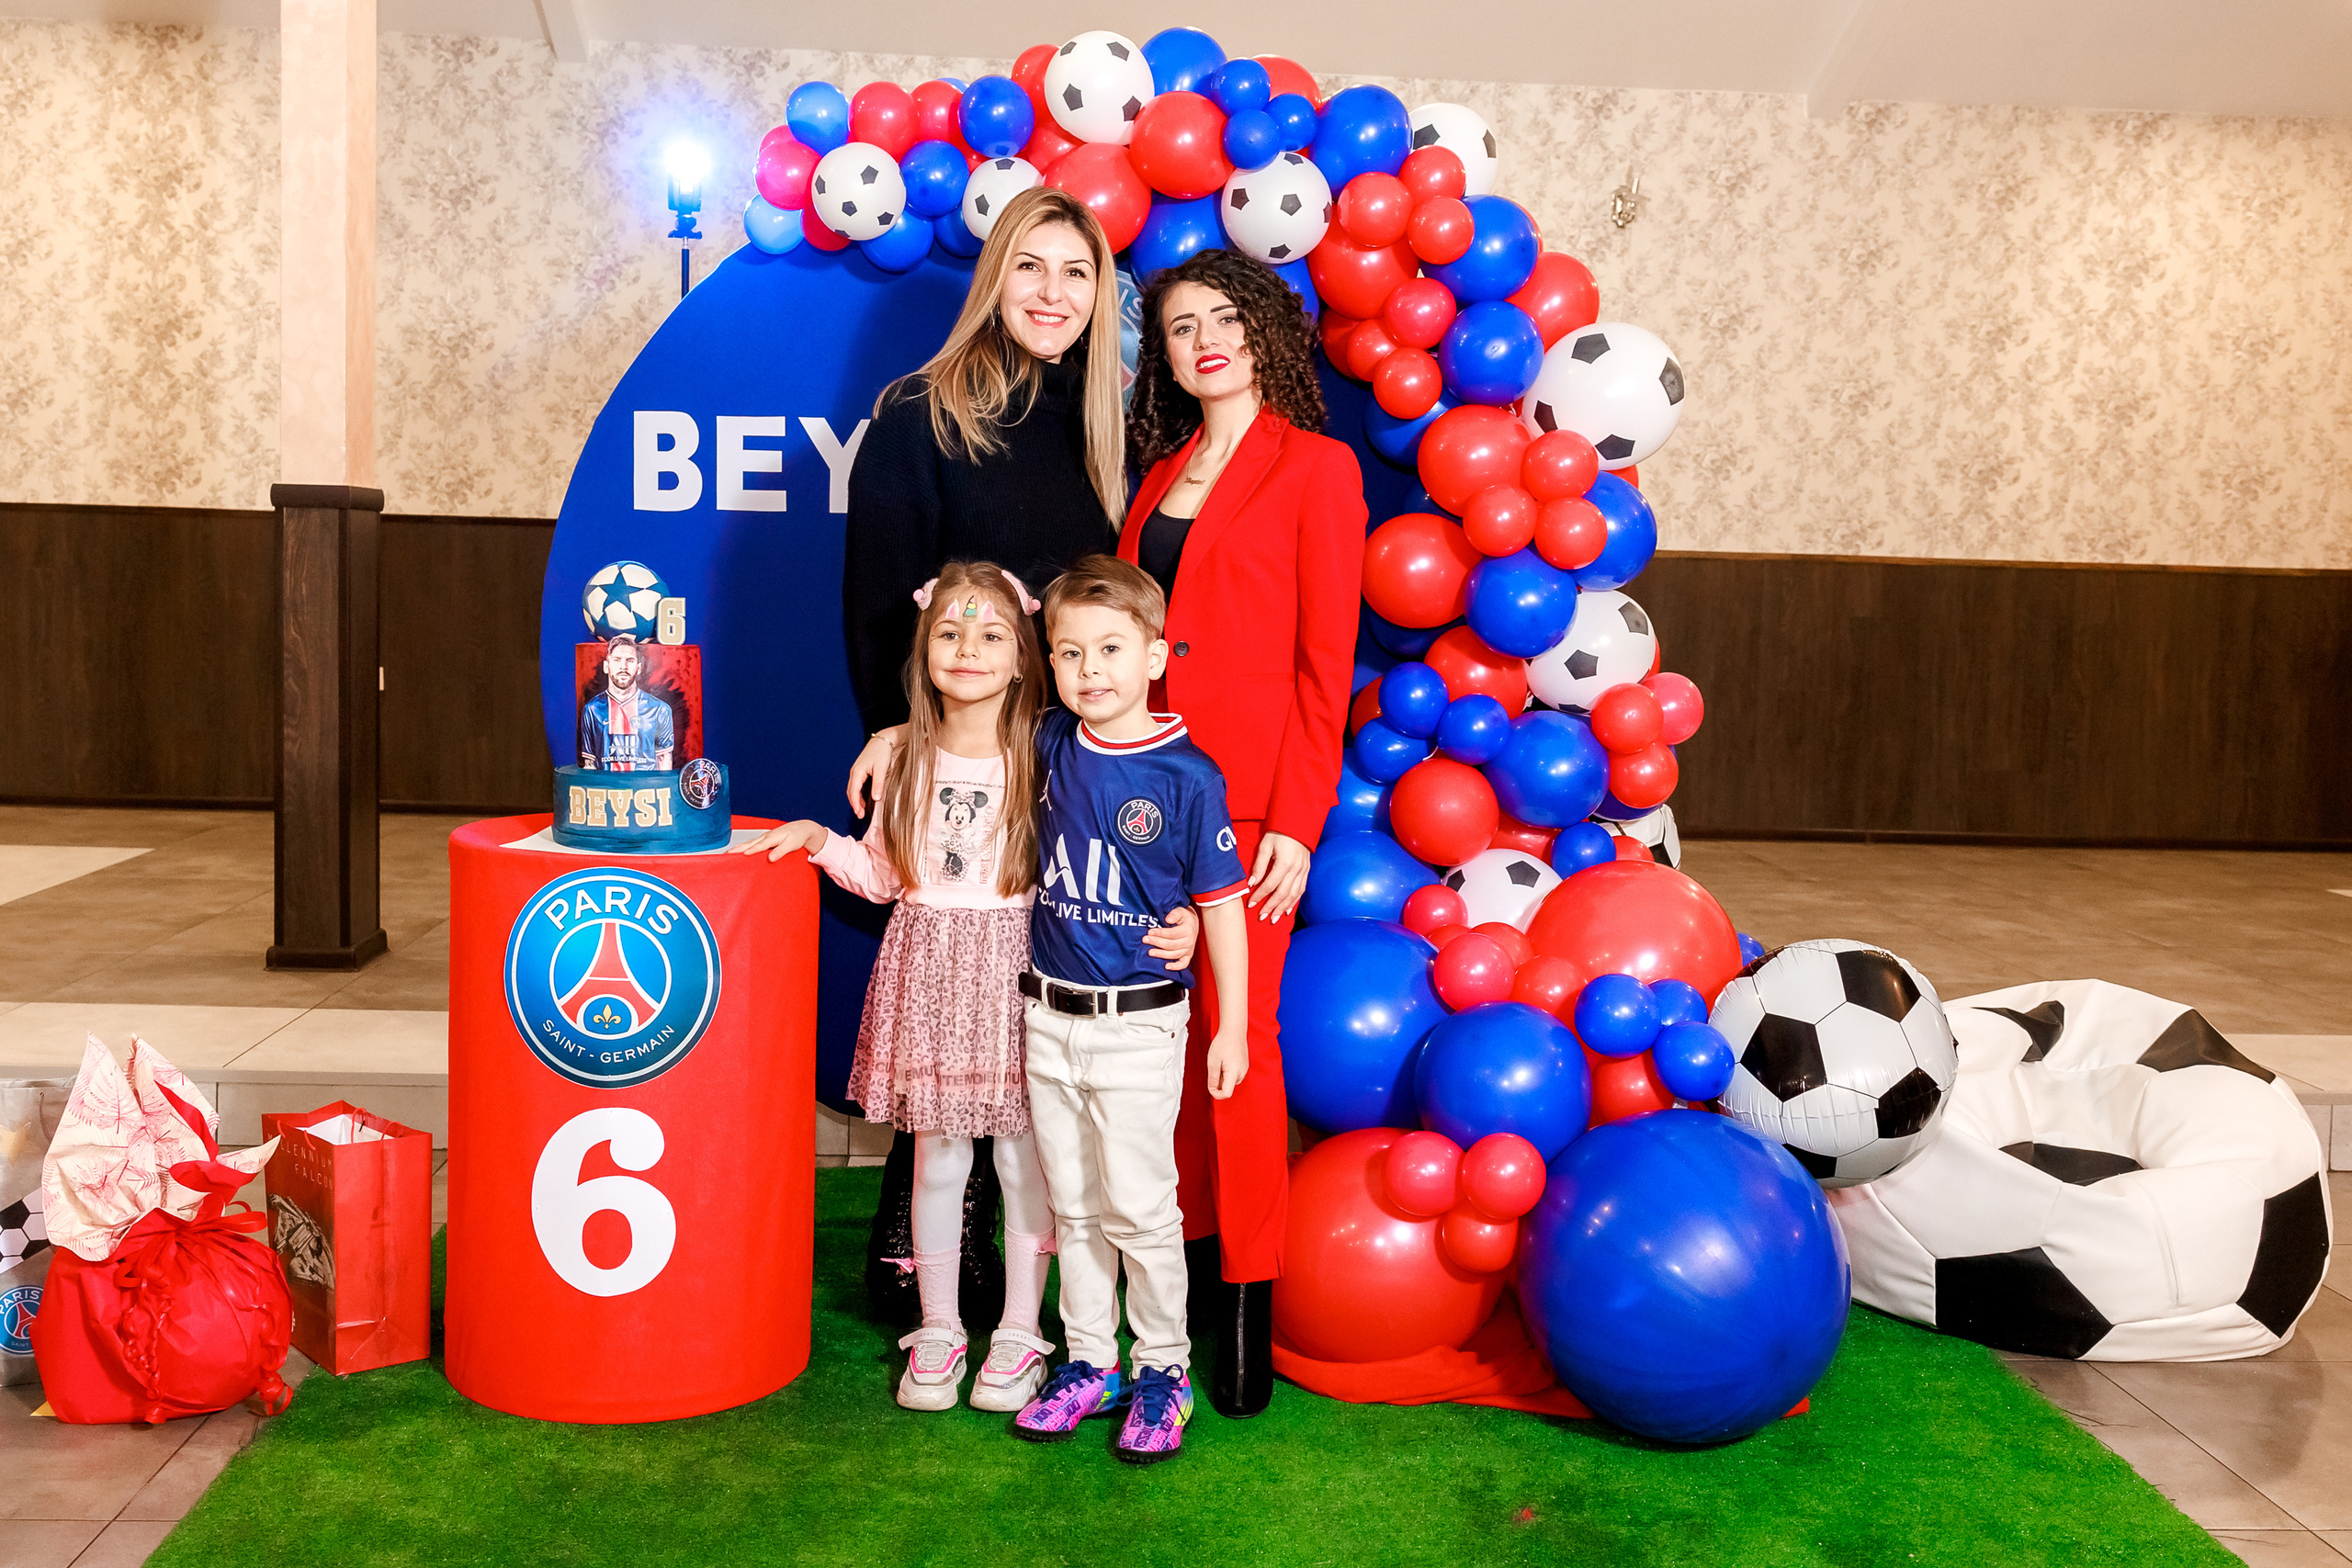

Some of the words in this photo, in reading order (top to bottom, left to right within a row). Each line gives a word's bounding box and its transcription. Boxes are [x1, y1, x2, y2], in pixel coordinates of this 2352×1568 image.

[634, 411, 871, 513] BEY
[657, 597, 686, 645] 6
[569, 785, 673, 828] BEYSI
[1131, 801, 1159, 818] PARIS
[544, 886, 680, 935] PARIS
[1056, 903, 1081, 920] IVE
[1088, 908, 1162, 929] LIMITLES
[267, 1133, 332, 1170] MLLENNIUM
[295, 1163, 333, 1190] FALCON
[531, 1107, 676, 1297] 6
[0, 1290, 40, 1314] PARIS
